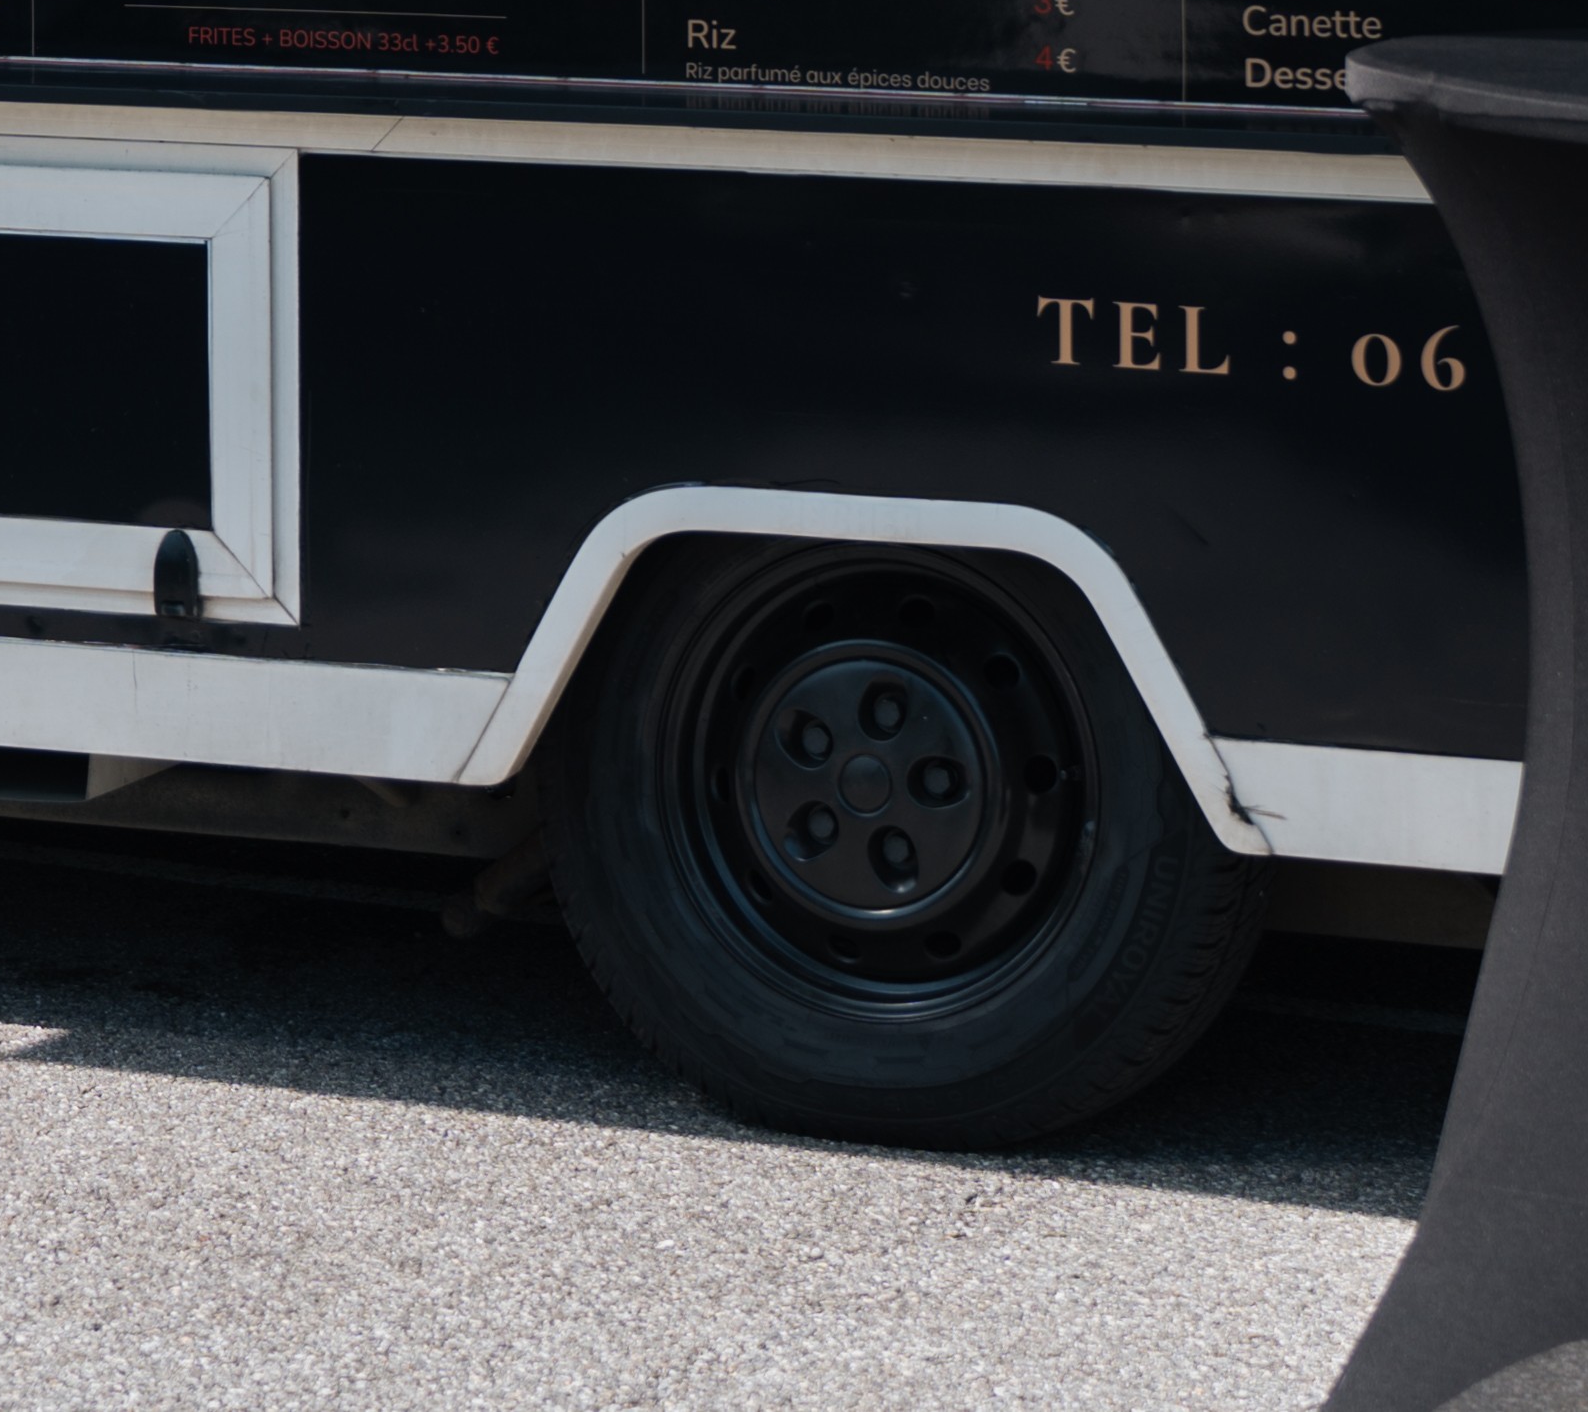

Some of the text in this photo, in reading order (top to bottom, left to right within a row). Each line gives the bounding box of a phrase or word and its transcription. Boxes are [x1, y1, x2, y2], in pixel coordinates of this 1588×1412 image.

[688, 19, 736, 49] Riz
[1242, 5, 1382, 39] Canette
[189, 26, 256, 46] FRITES
[262, 33, 273, 45] +
[280, 29, 373, 49] BOISSON
[377, 32, 418, 52] 33cl
[426, 34, 480, 54] +3.50
[686, 63, 989, 91] Riz parfumé aux épices douces
[1037, 296, 1466, 391] TEL : 06
